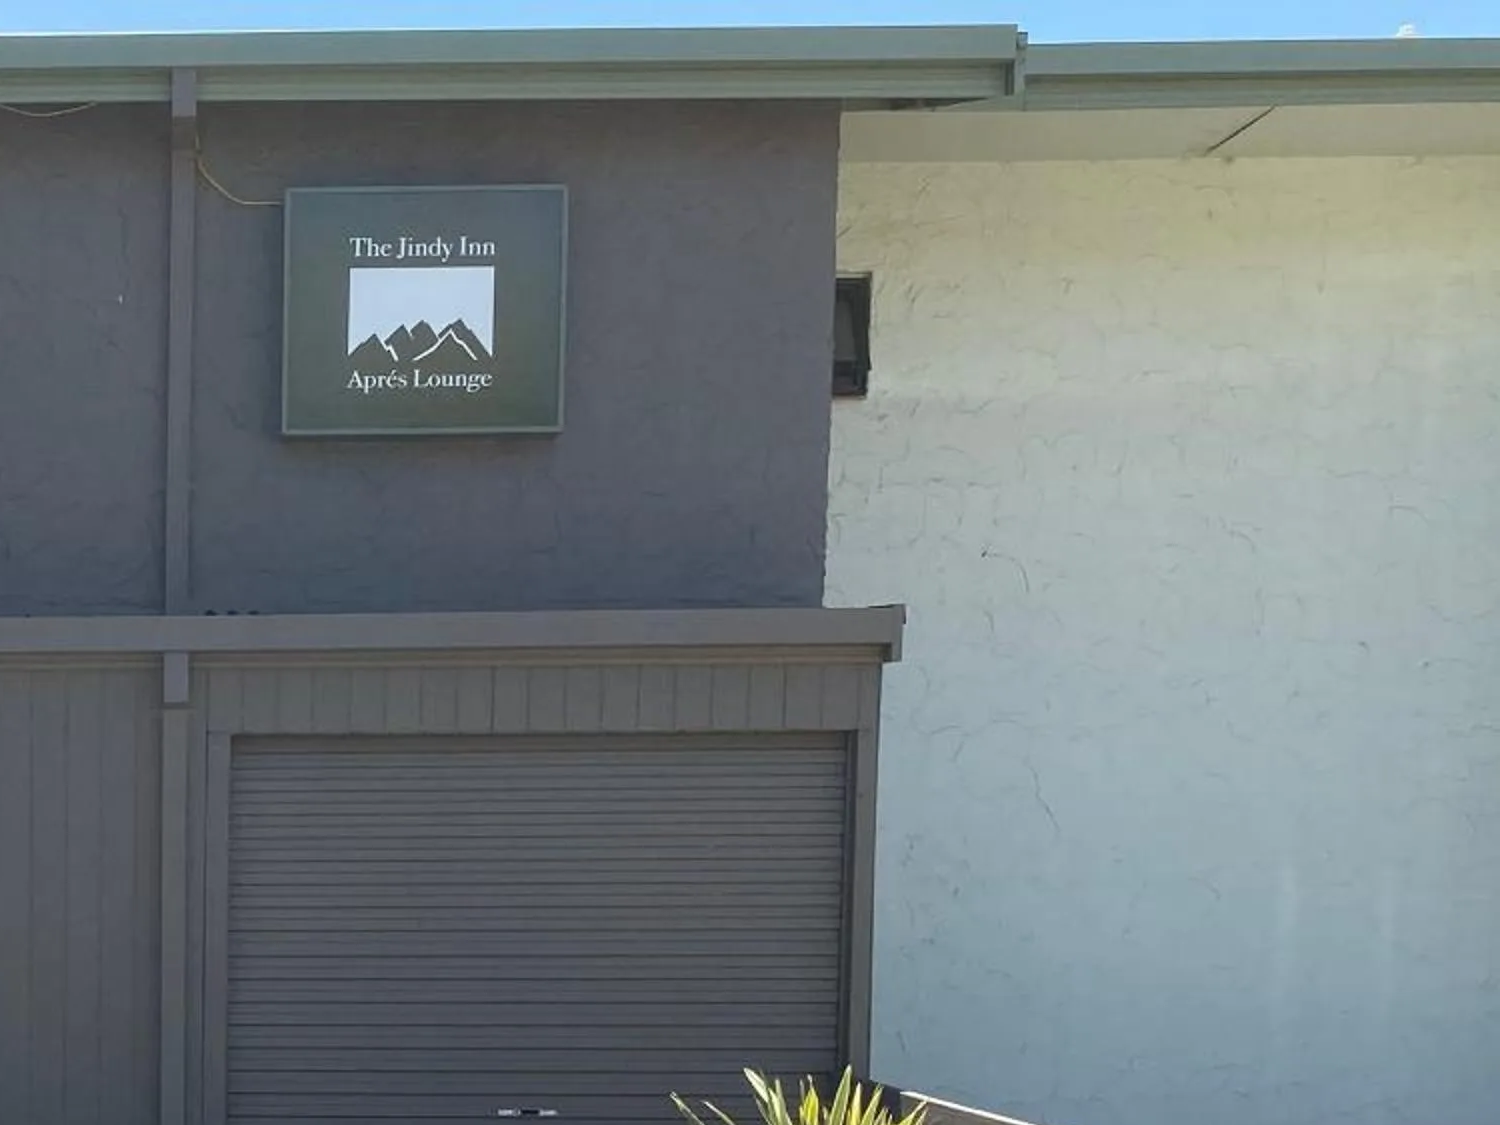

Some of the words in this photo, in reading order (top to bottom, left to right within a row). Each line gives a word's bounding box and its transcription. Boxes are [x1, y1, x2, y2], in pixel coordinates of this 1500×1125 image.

[349, 237, 392, 257] The
[396, 236, 453, 263] Jindy
[459, 235, 495, 256] Inn
[347, 369, 408, 394] Aprés
[413, 368, 493, 393] Lounge
